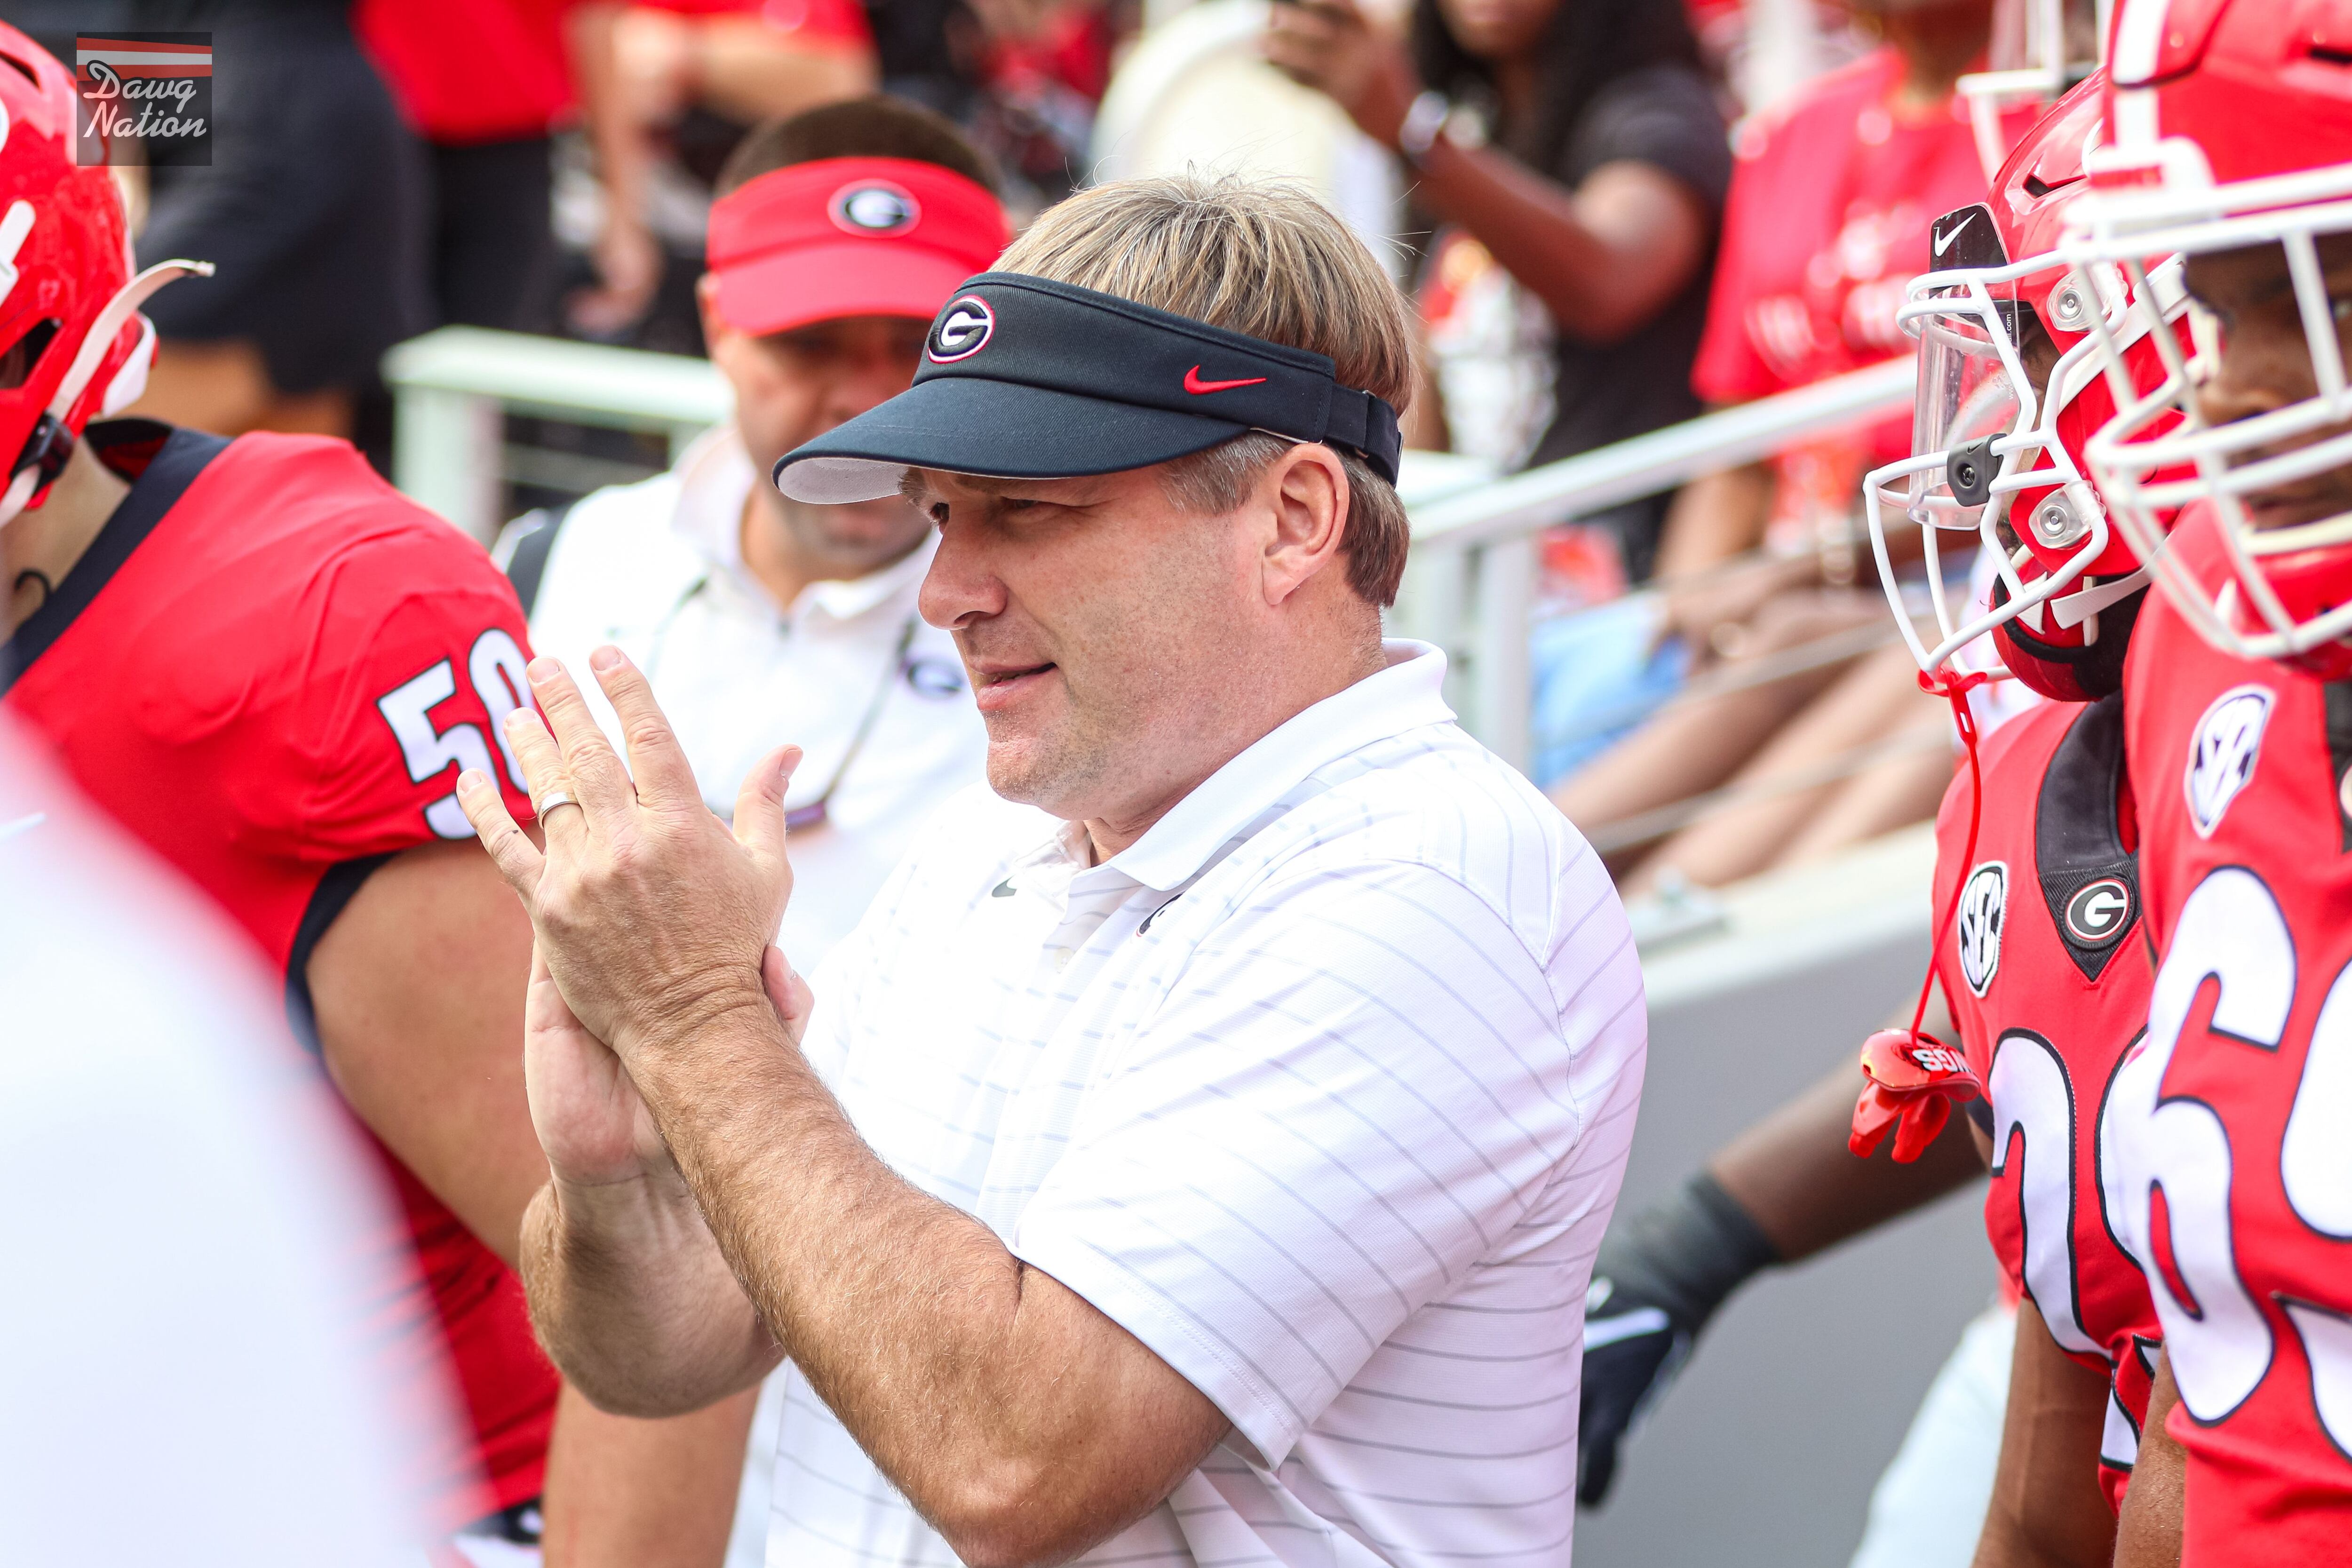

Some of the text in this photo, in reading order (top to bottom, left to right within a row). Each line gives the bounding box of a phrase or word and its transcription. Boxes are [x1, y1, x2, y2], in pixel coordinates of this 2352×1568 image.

[929, 299, 992, 360] G
[1960, 866, 2002, 991] SEC
[2070, 883, 2126, 937] G
